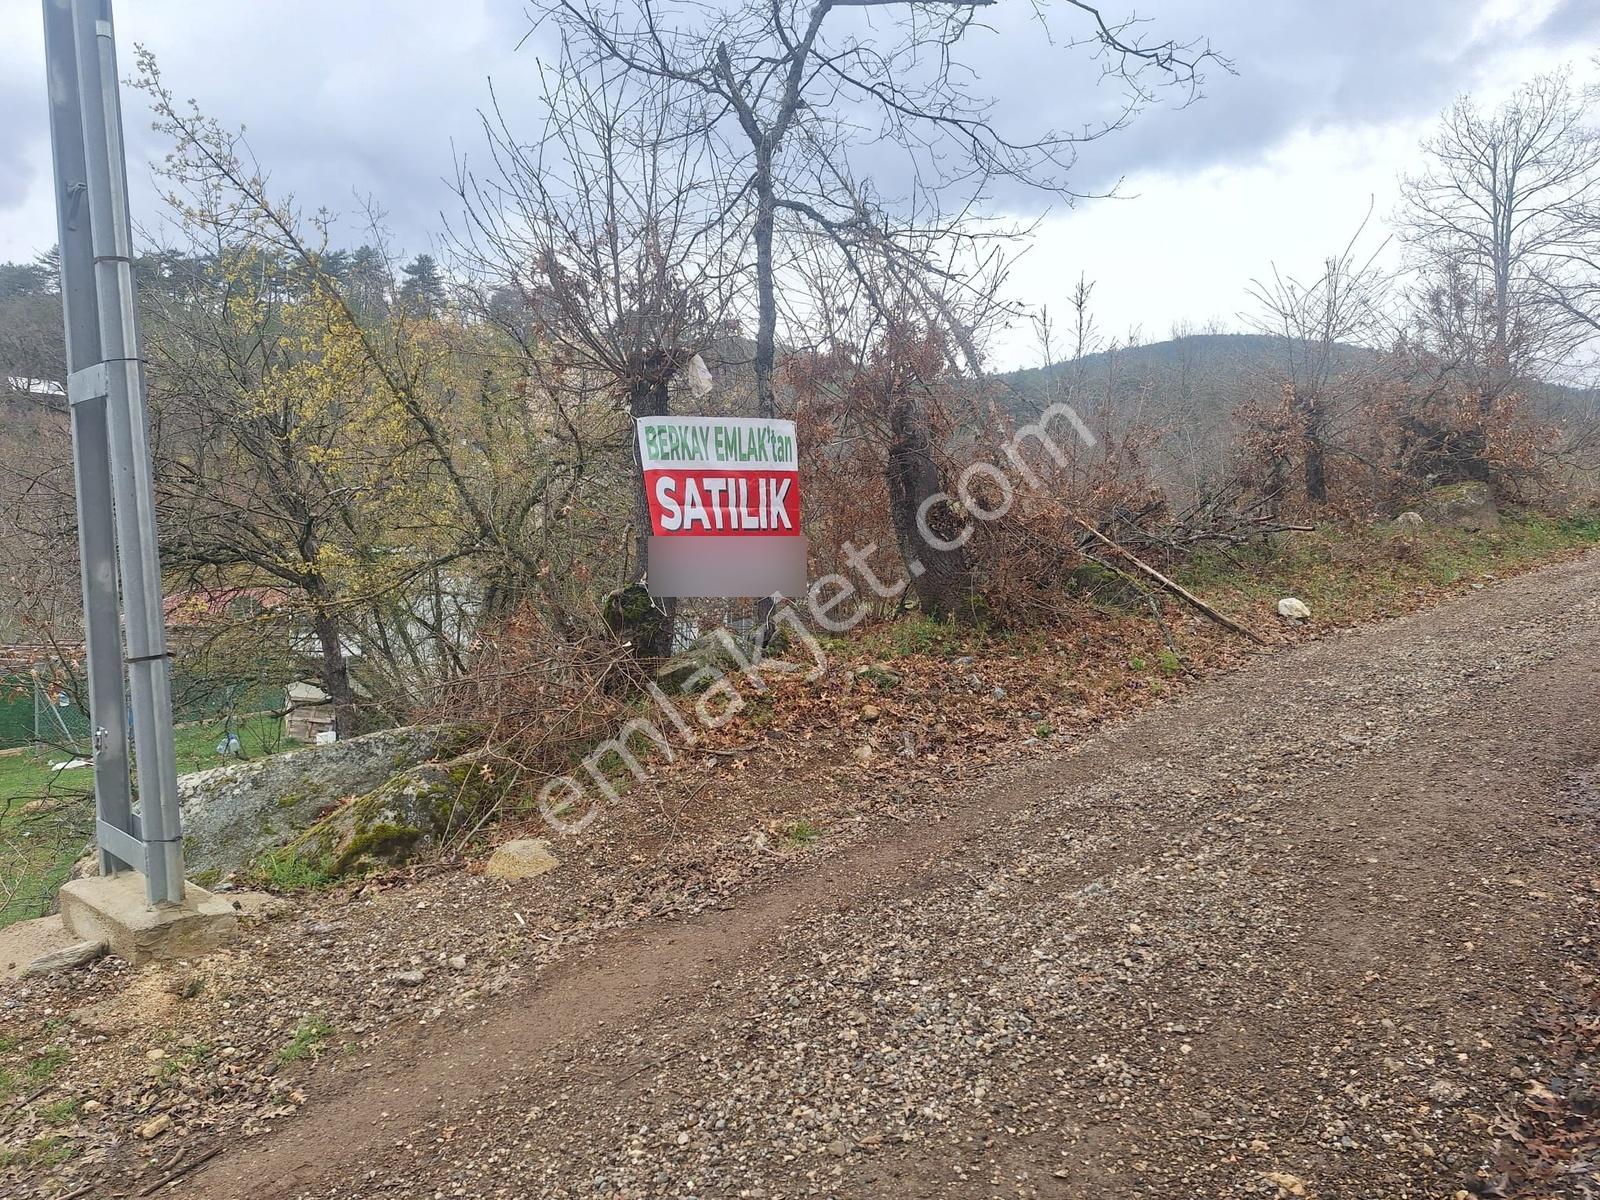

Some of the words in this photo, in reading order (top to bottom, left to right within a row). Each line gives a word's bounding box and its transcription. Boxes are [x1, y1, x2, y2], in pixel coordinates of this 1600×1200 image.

[644, 424, 710, 461] BERKAY
[714, 425, 793, 463] EMLAK'tan
[655, 476, 793, 532] SATILIK
